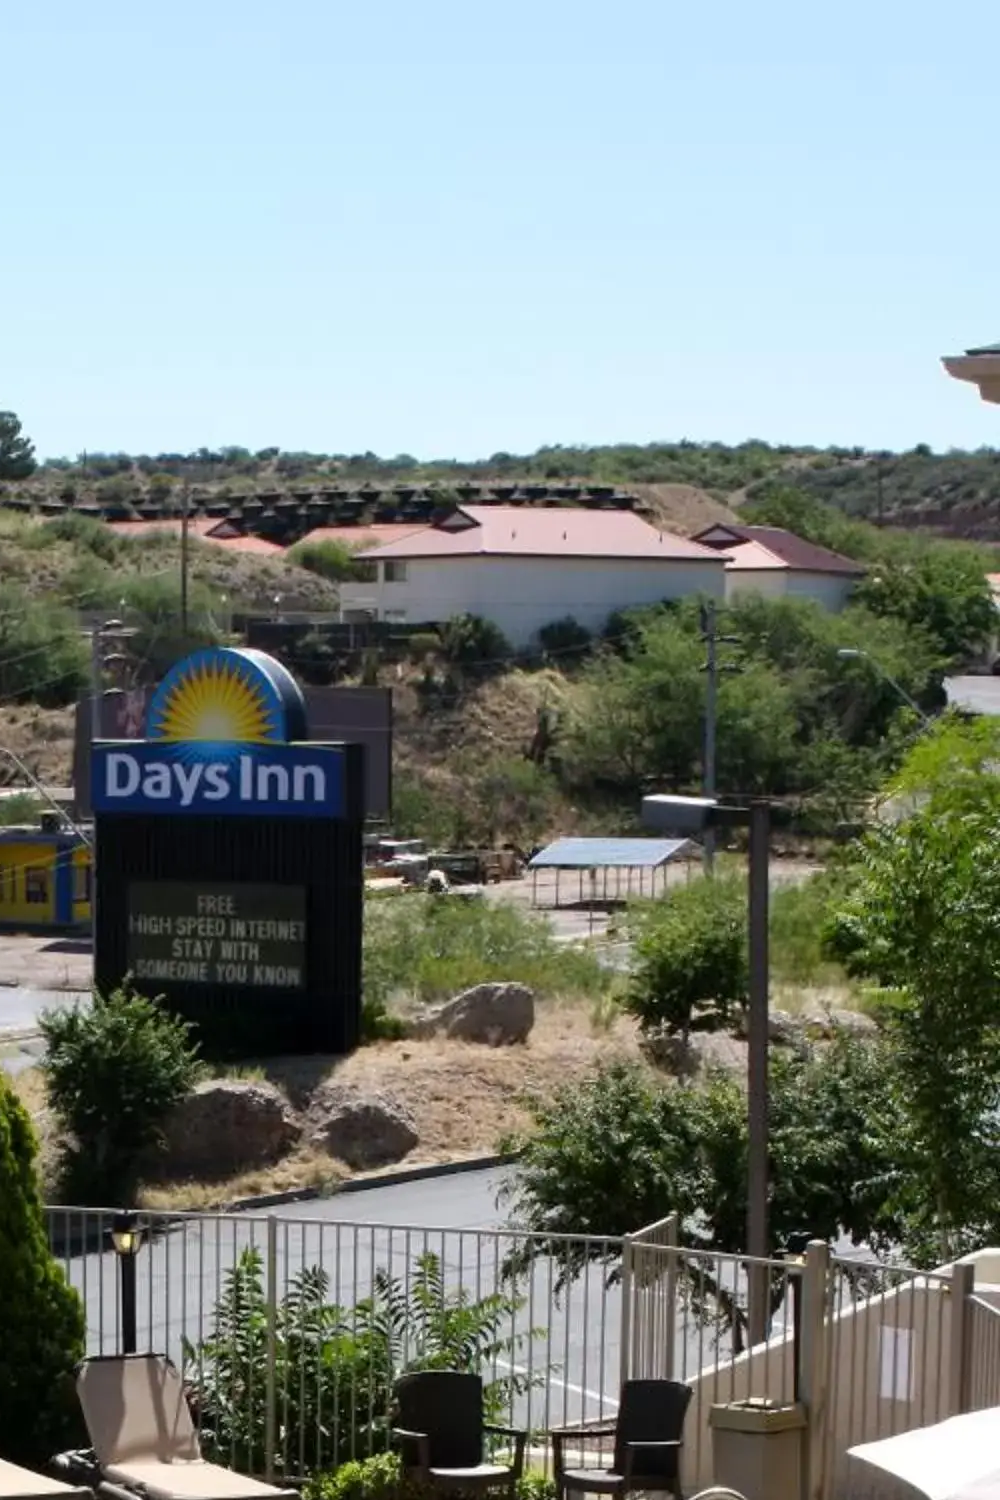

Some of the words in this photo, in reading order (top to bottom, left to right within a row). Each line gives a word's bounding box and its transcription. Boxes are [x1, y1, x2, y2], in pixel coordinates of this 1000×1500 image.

[106, 753, 231, 807] Days
[240, 754, 326, 801] Inn
[197, 894, 237, 915] FREE
[129, 913, 172, 935] HIGH
[176, 916, 226, 937] SPEED
[230, 919, 305, 941] INTERNET
[172, 937, 214, 959] STAY
[220, 940, 260, 961] WITH
[136, 959, 209, 981] SOMEONE
[216, 963, 249, 983] YOU
[253, 965, 301, 986] KNOW
